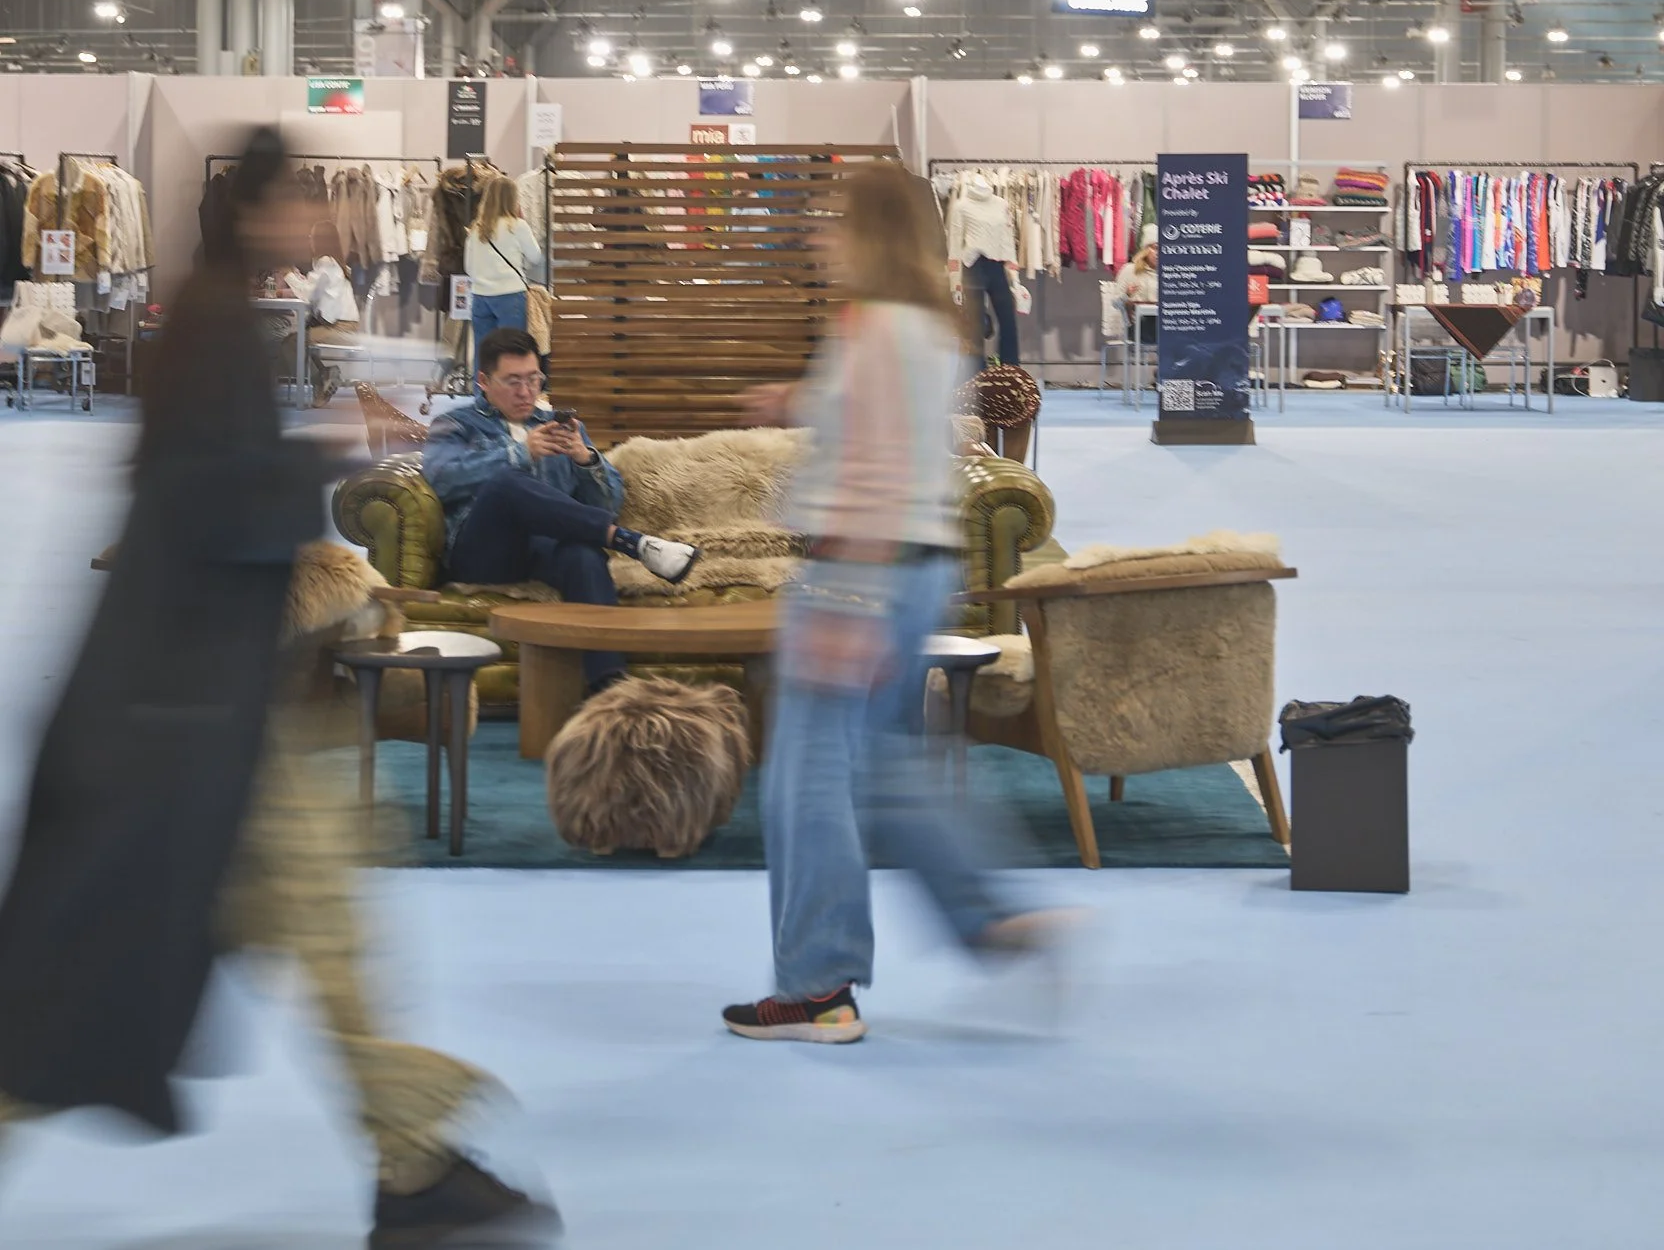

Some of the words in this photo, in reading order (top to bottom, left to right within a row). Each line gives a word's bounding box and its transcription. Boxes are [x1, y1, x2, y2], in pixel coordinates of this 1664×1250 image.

[692, 129, 725, 144] mia
[1161, 171, 1204, 187] Après
[1205, 171, 1229, 185] Ski
[1161, 186, 1210, 200] Chalet
[1180, 223, 1223, 234] COTERIE
